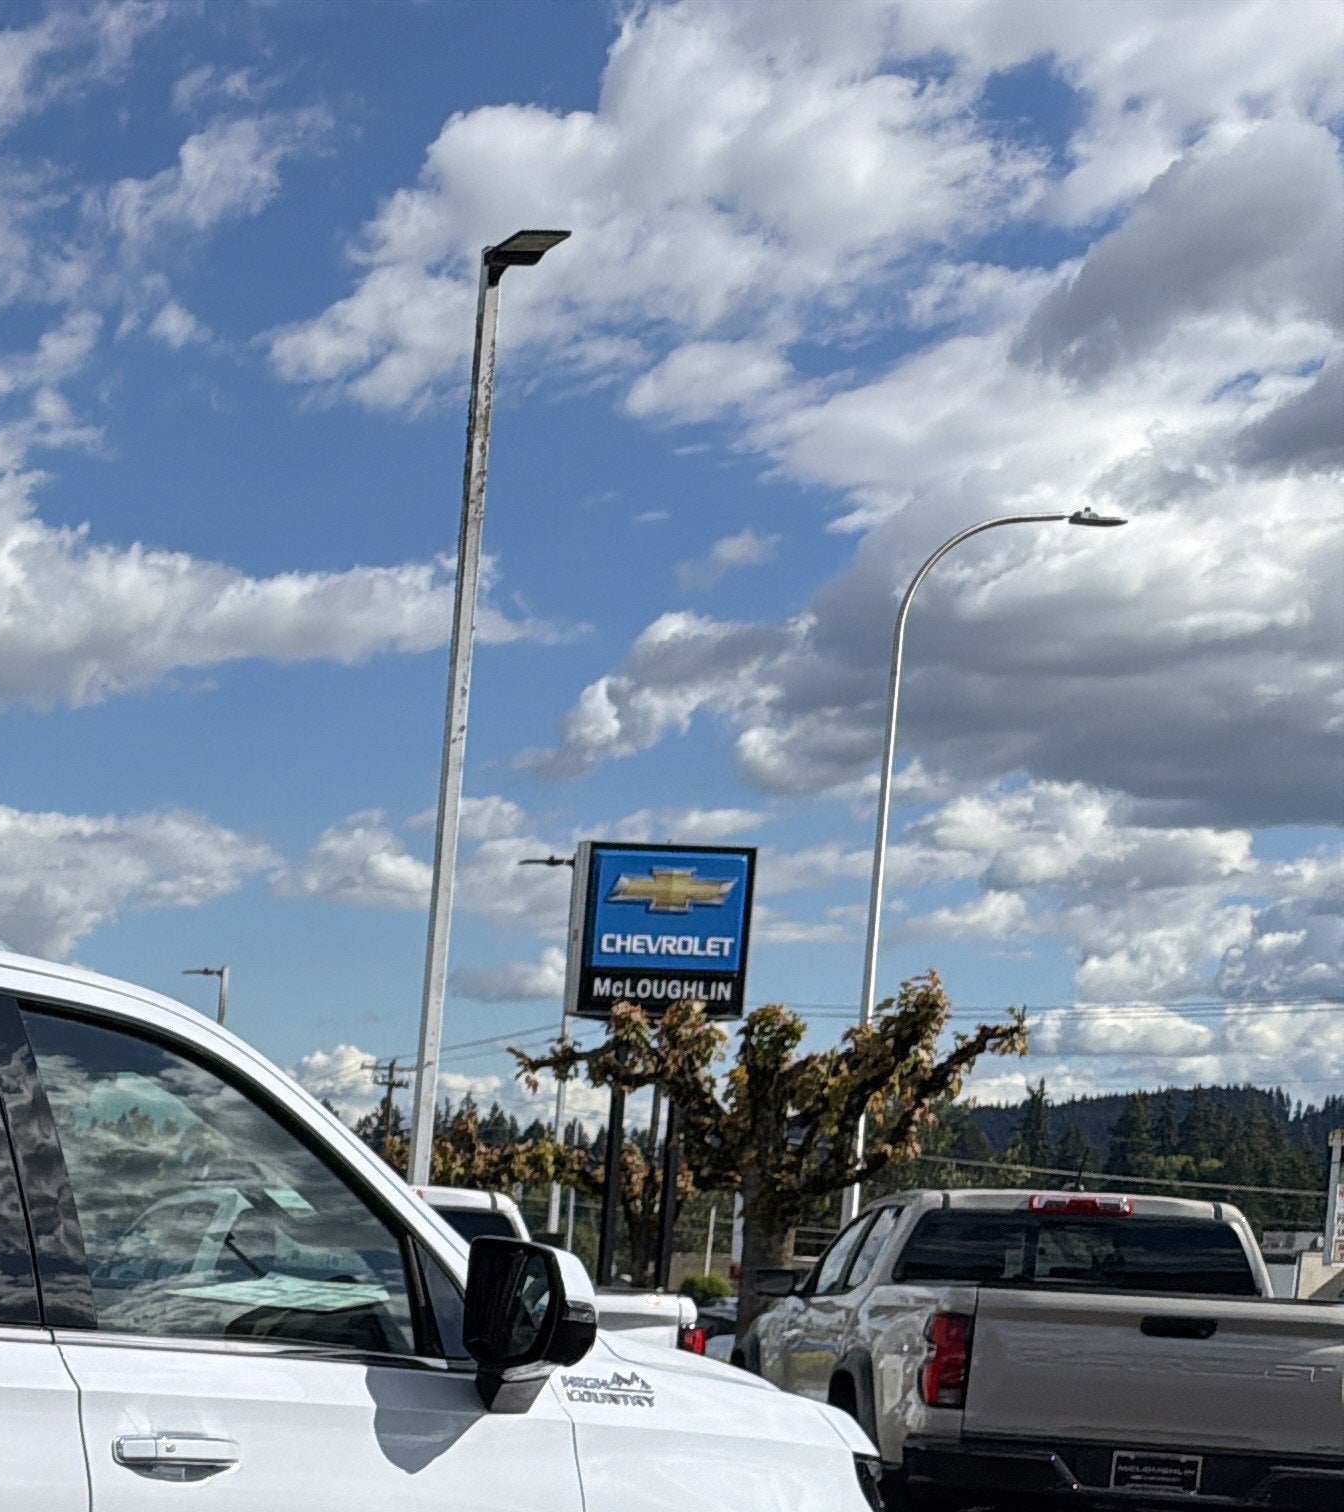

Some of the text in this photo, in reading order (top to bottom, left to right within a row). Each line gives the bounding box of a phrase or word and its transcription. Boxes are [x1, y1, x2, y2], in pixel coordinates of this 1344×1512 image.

[600, 933, 735, 957] CHEVROLET
[592, 976, 733, 1002] McLOUGHLIN
[560, 1374, 609, 1389] HIGH
[566, 1389, 655, 1408] COUNTRY
